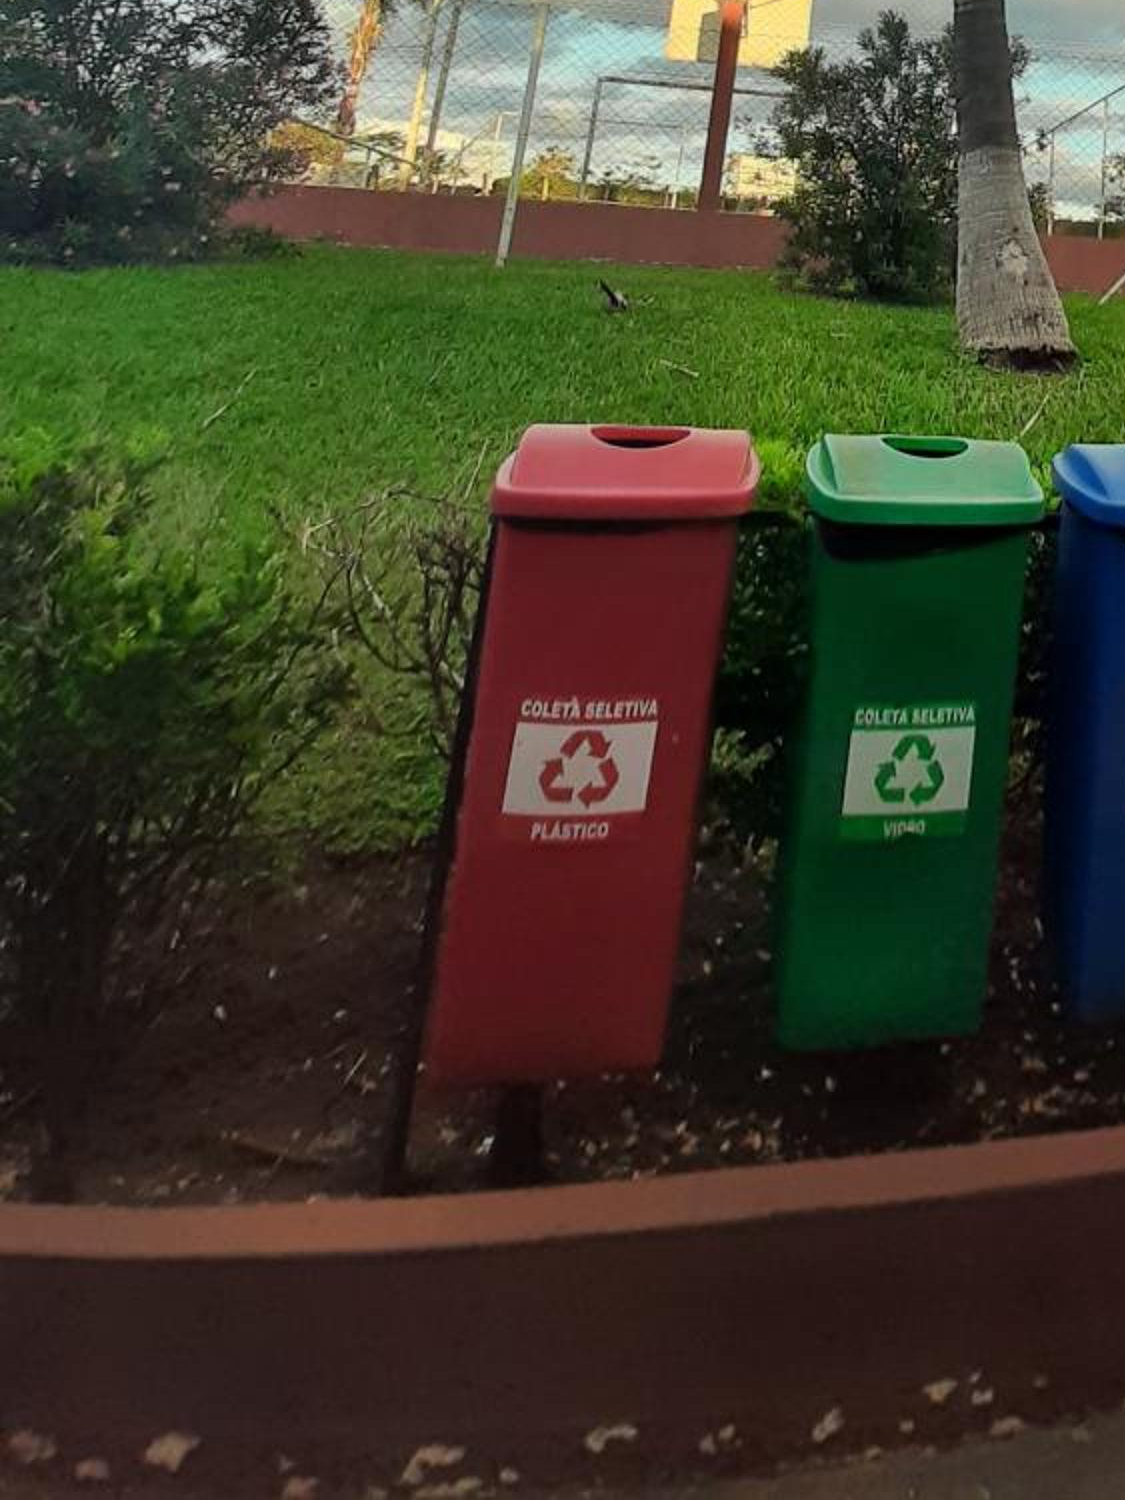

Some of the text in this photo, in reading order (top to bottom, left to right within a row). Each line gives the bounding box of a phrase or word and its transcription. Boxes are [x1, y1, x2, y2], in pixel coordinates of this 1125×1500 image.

[521, 697, 657, 720] COLETA SELETIVA
[855, 705, 976, 725] COLETA SELETIVA
